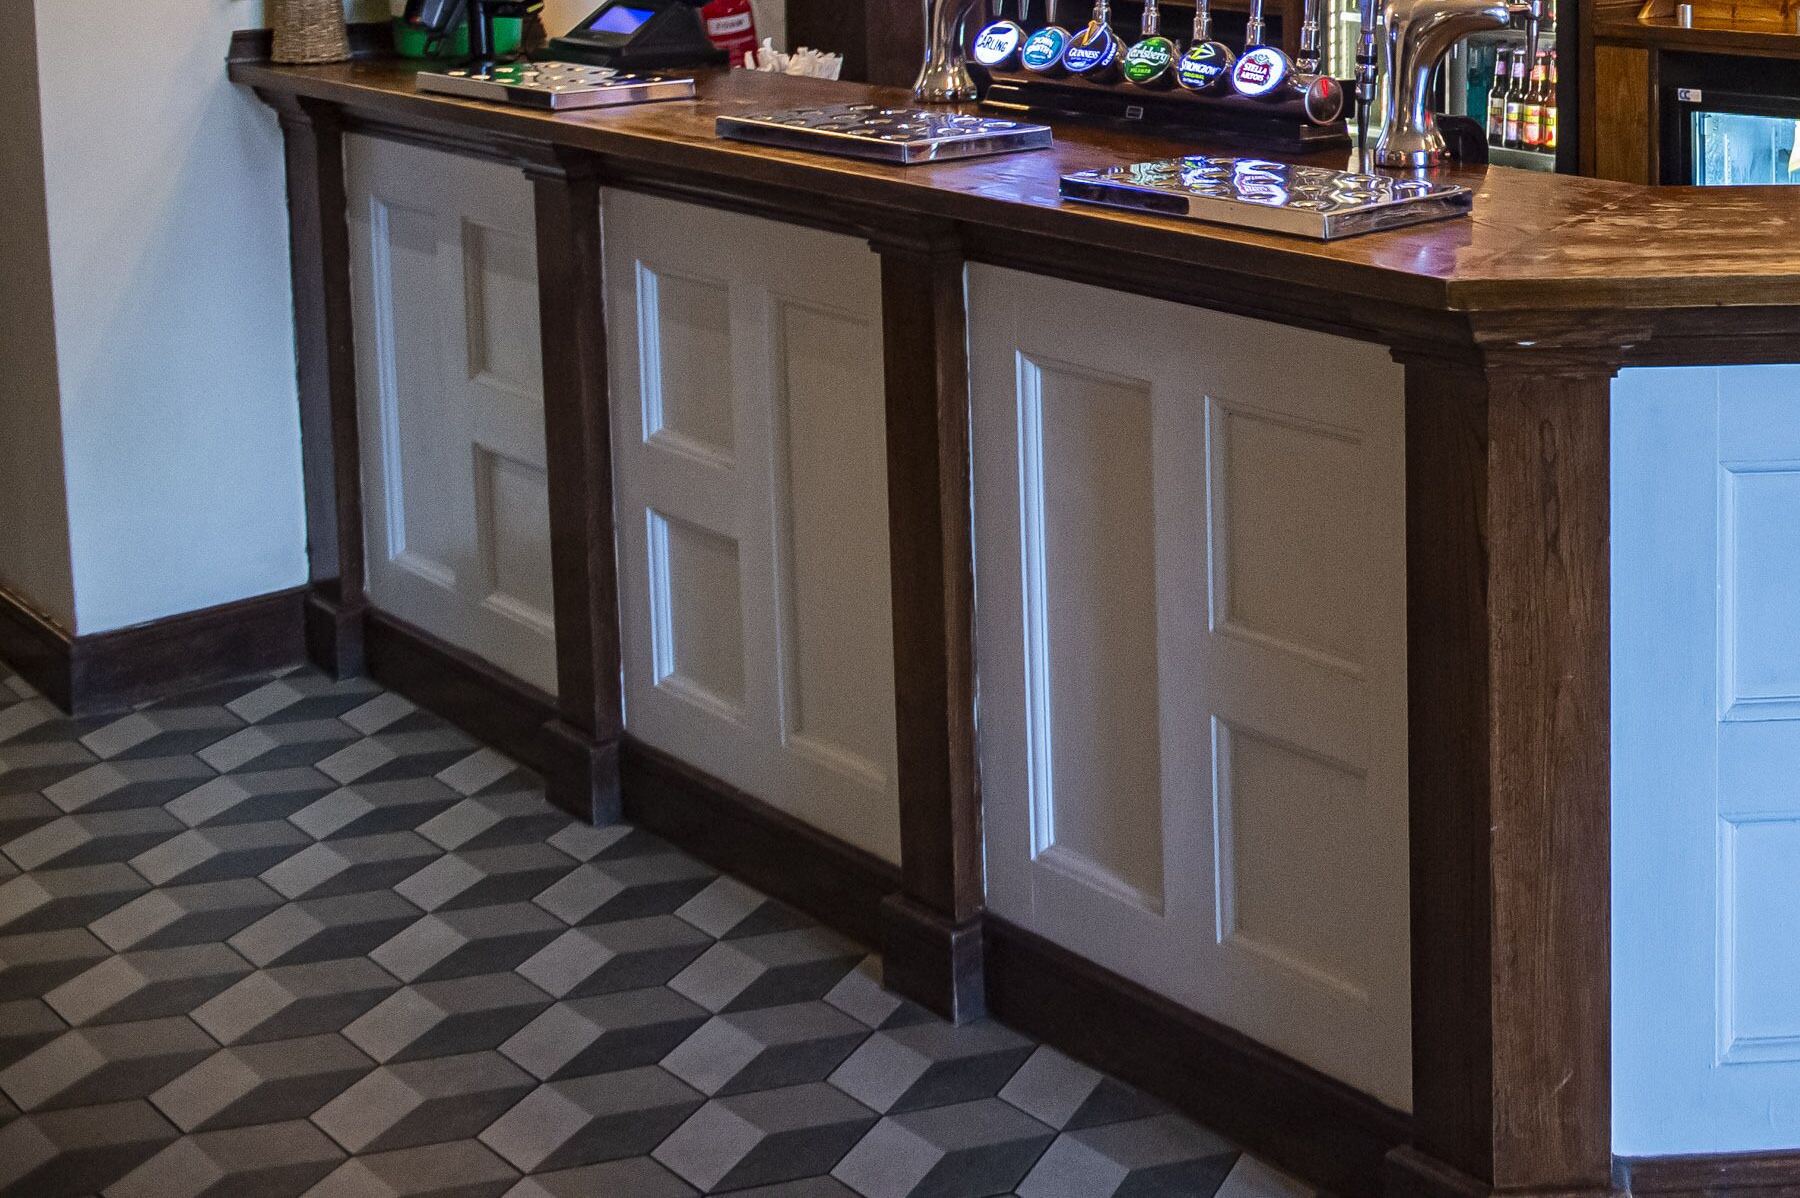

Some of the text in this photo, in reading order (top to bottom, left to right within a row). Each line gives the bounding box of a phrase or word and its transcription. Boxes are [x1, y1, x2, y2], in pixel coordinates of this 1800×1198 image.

[1126, 41, 1171, 65] Carlsberg
[1242, 62, 1268, 76] STELLA
[1240, 71, 1265, 82] ARTOIS
